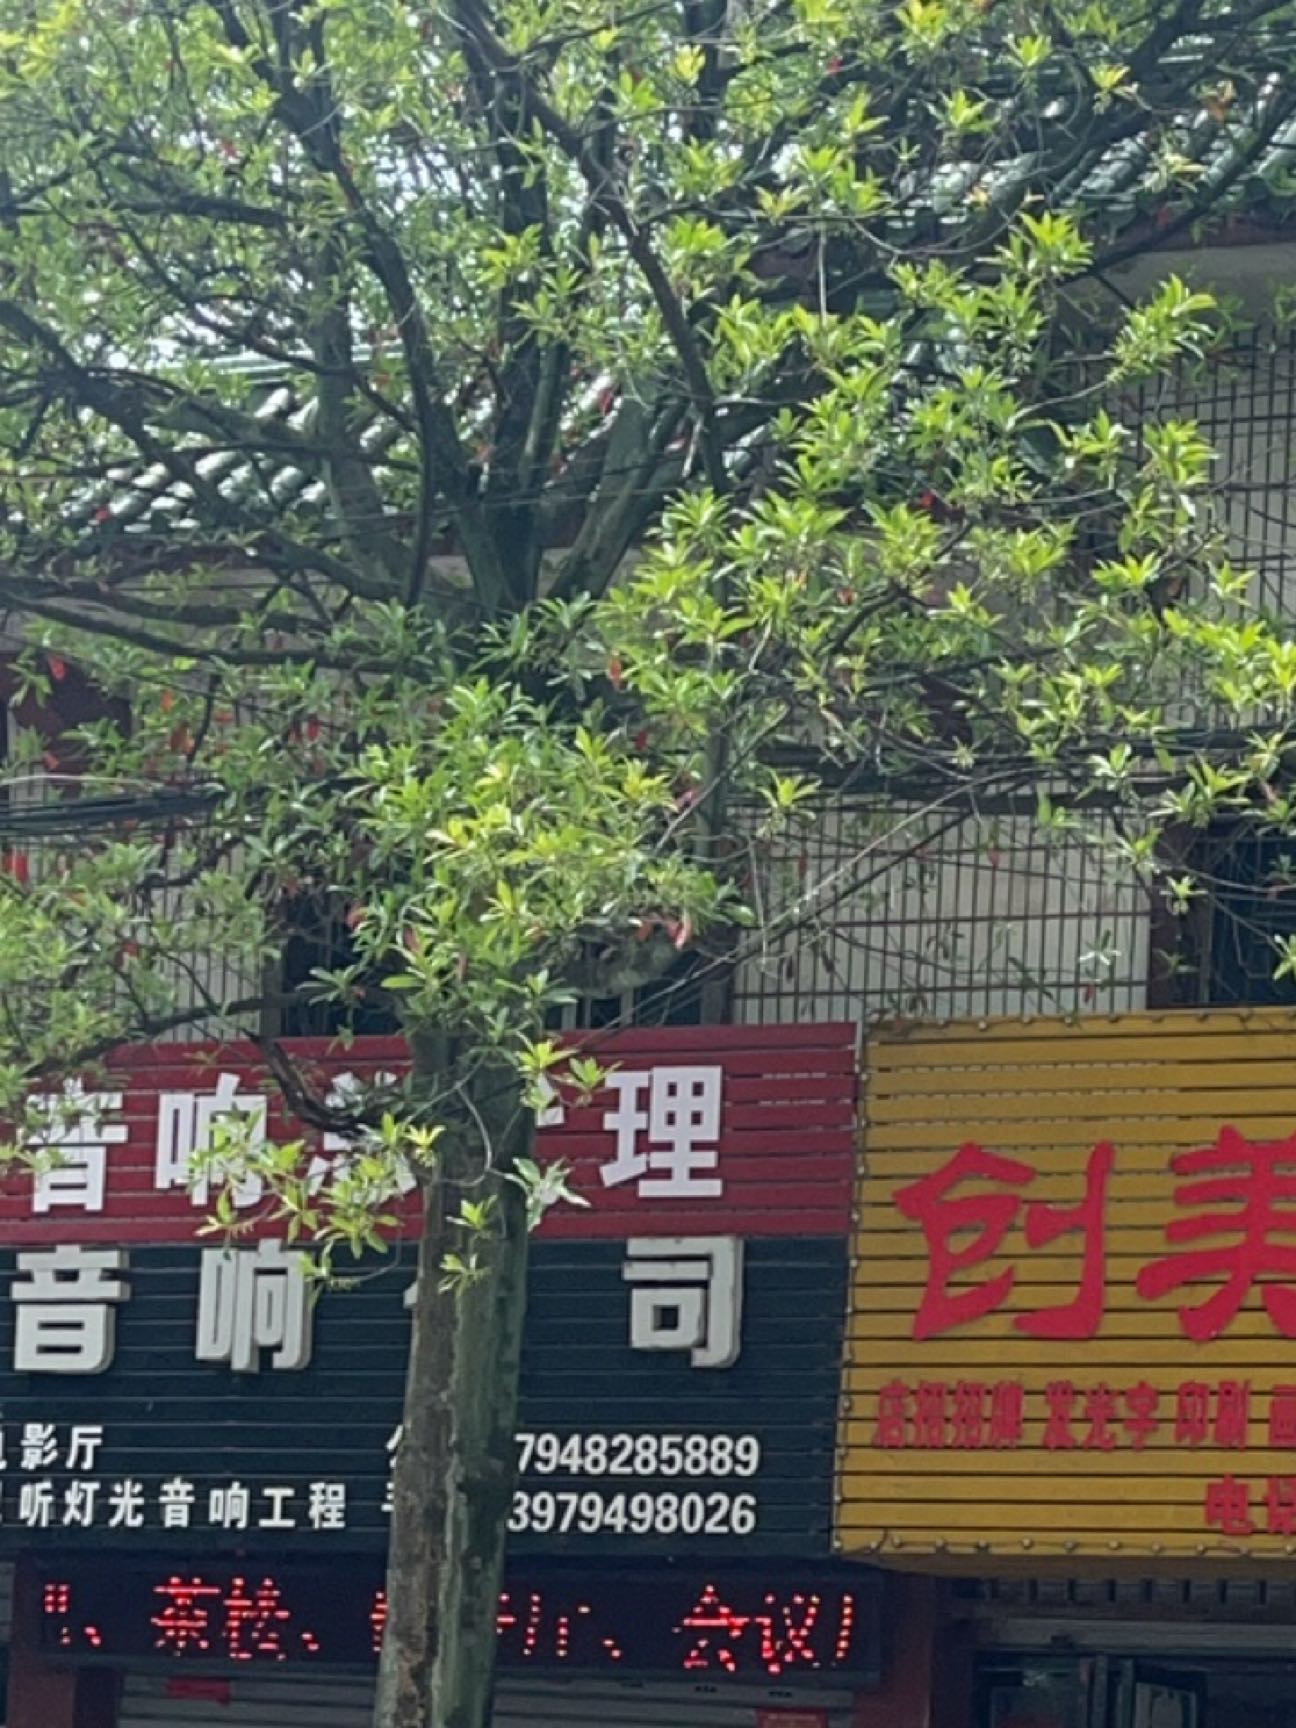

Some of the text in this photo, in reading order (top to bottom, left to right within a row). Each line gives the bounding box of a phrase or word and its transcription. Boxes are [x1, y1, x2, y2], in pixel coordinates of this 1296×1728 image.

[18, 1065, 723, 1213] 音响理
[10, 1236, 745, 1374] 音响司
[1042, 1379, 1161, 1453] 发光字
[1174, 1379, 1252, 1452] 印刷
[512, 1432, 761, 1477] 7948285889
[0, 1475, 347, 1529] 听灯光音响工程
[505, 1490, 757, 1535] 3979498026
